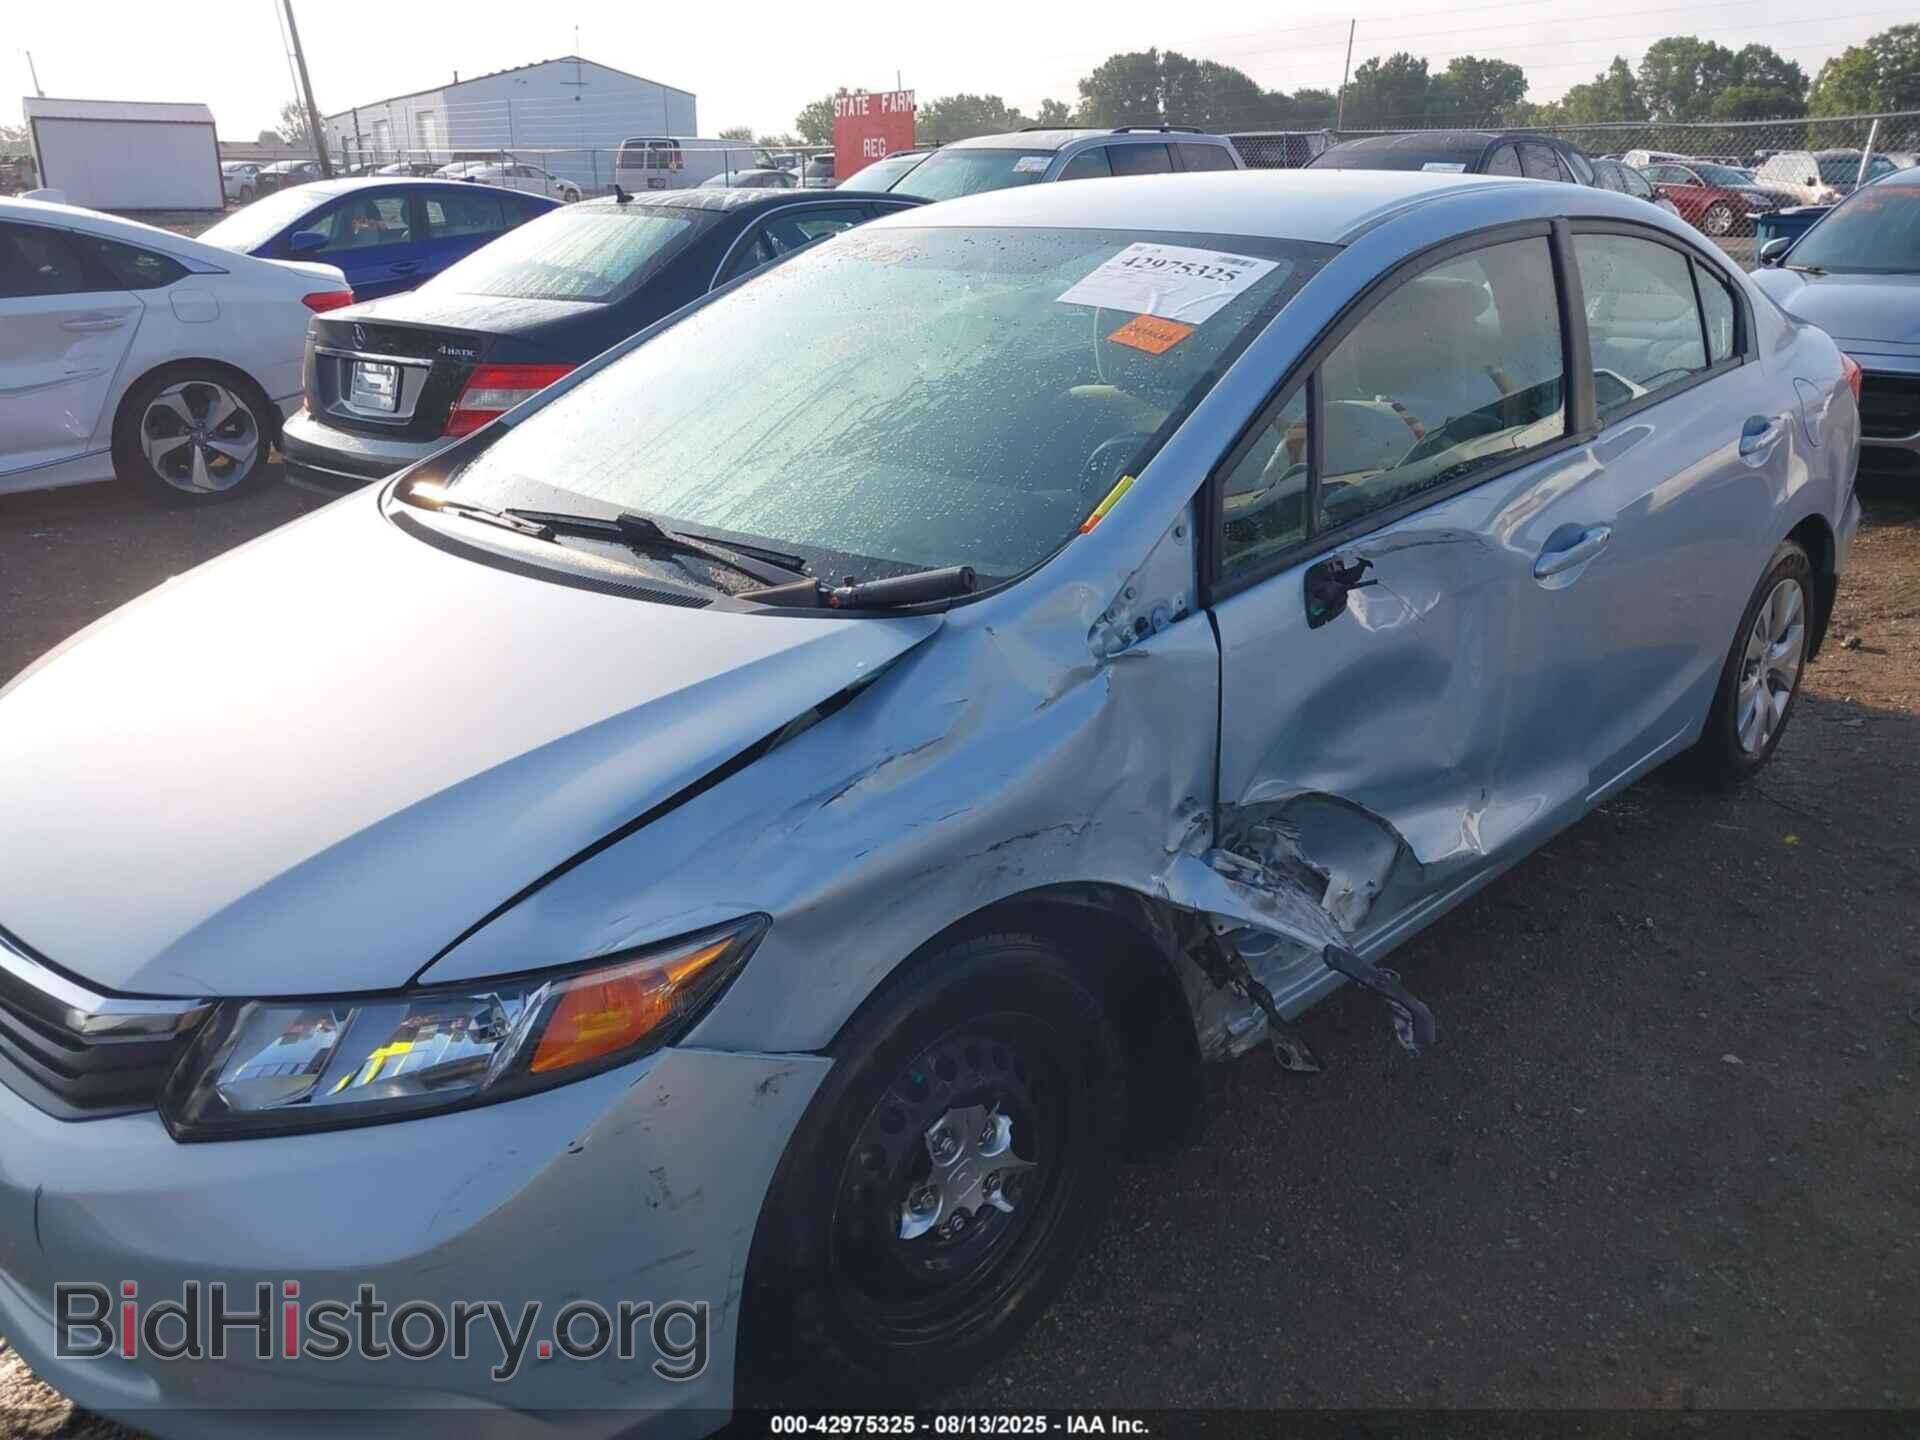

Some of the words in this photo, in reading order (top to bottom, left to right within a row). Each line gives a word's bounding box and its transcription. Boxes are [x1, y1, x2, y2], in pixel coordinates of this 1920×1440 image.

[834, 95, 870, 117] STATE
[881, 91, 914, 113] FARM
[863, 137, 886, 158] REG
[1120, 255, 1241, 283] 42975325
